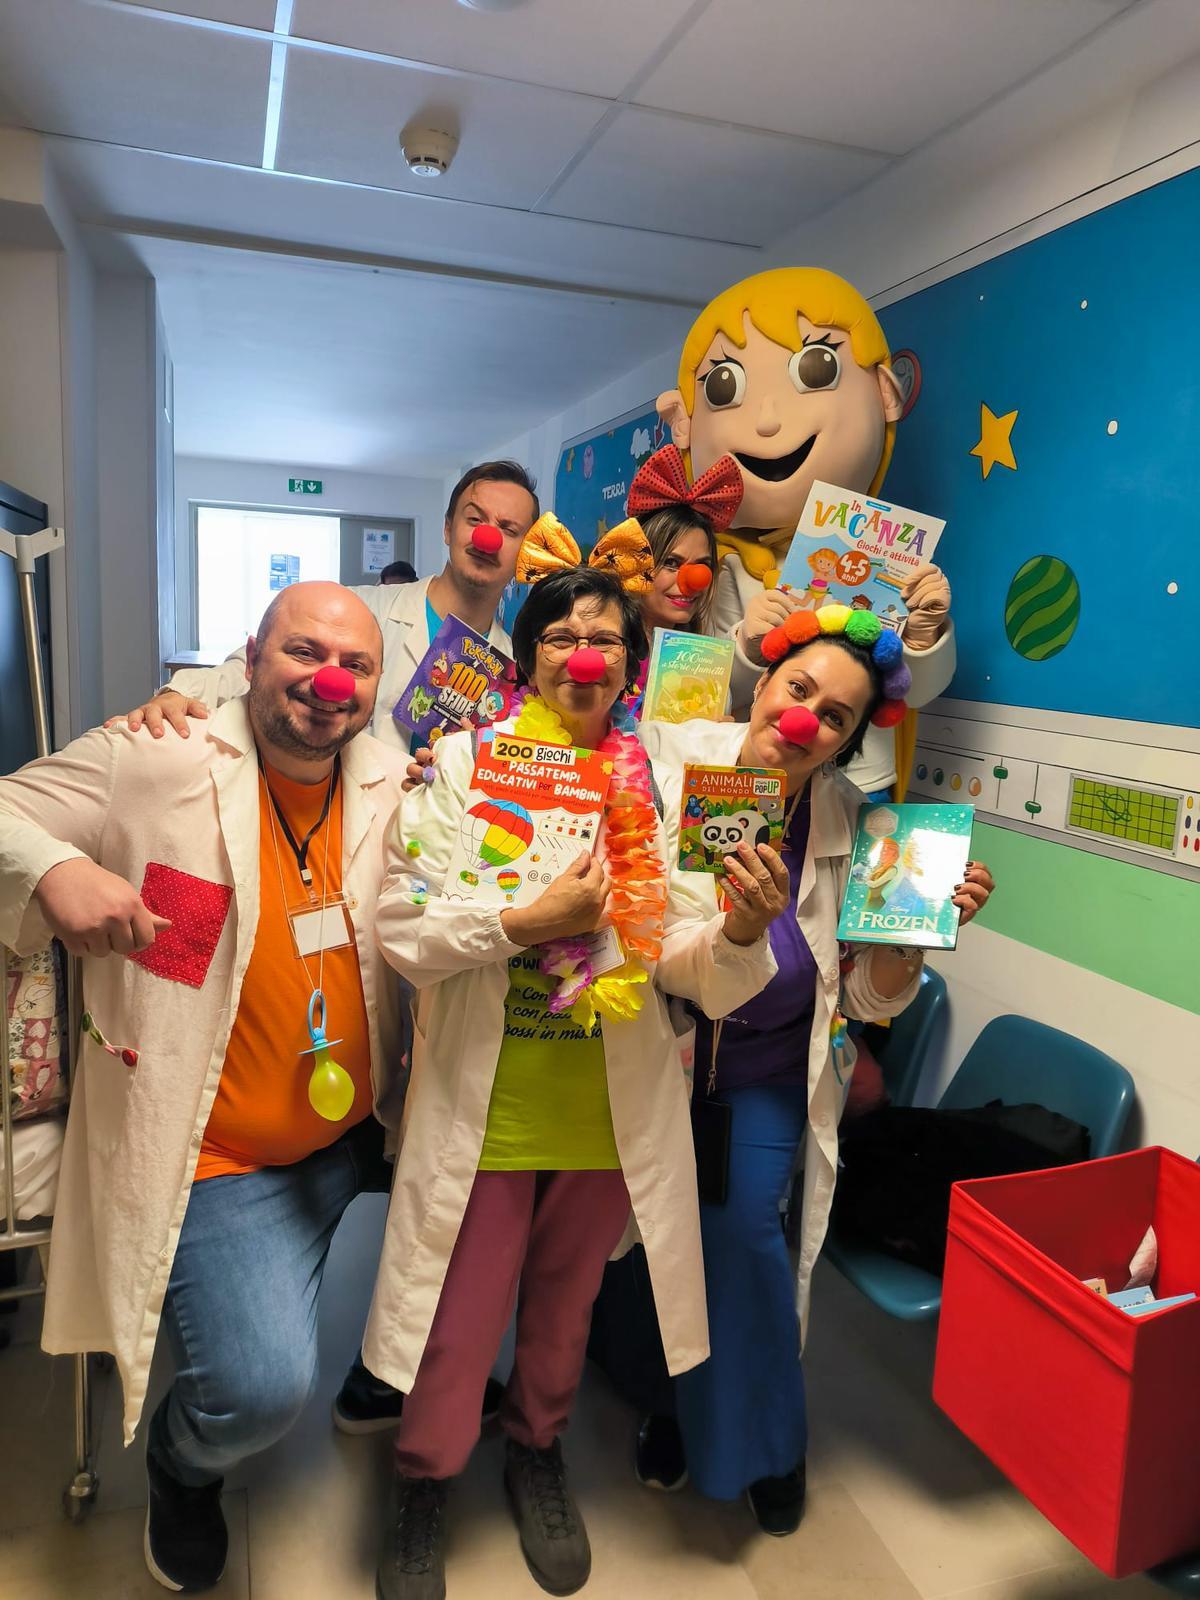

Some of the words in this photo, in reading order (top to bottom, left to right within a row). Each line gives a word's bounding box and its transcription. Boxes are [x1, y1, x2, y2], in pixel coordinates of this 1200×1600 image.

[602, 482, 626, 500] TERRA
[851, 500, 861, 512] In
[814, 500, 928, 556] VACANZA
[857, 540, 882, 557] Giochi
[840, 554, 869, 577] 4-5
[841, 573, 858, 583] anni
[675, 651, 699, 663] 100
[448, 663, 489, 702] 100
[438, 687, 478, 718] SFIDE
[496, 742, 533, 759] 200
[535, 747, 572, 764] giochi
[508, 761, 581, 783] PASSATEMPI
[701, 774, 753, 787] ANIMALI
[477, 768, 537, 790] EDUCATIVI
[538, 782, 552, 792] per
[553, 783, 602, 802] BAMBINI
[857, 911, 938, 931] FROZEN
[513, 1006, 539, 1018] con
[539, 1026, 555, 1040] in
